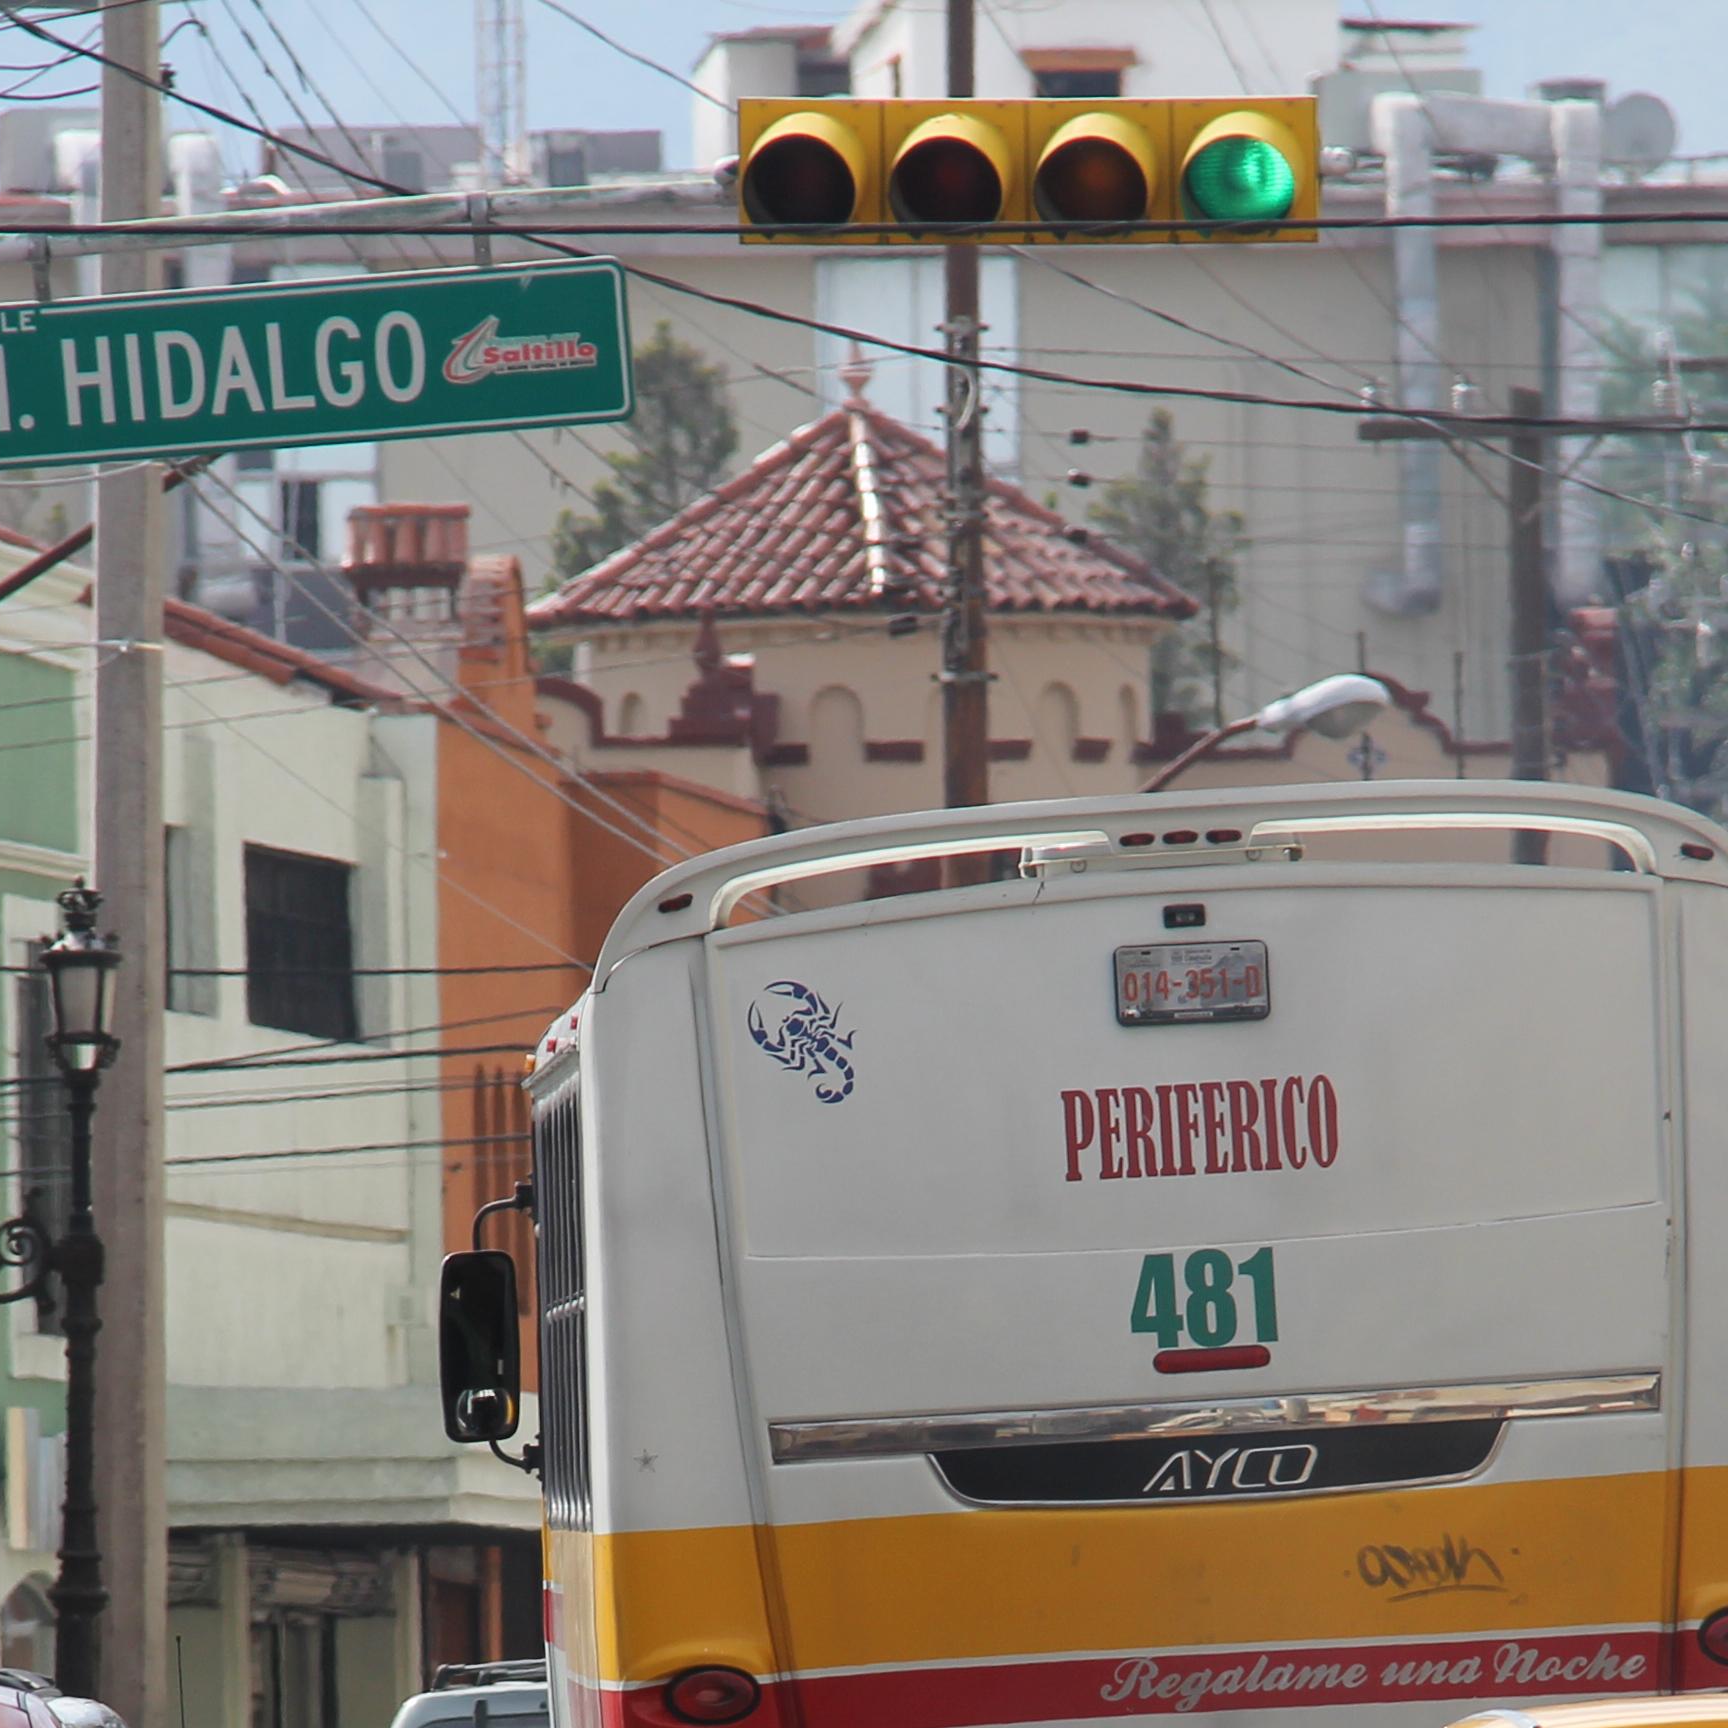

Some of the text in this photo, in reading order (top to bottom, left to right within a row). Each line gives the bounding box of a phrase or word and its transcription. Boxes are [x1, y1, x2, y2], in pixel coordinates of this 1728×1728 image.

[61, 310, 426, 427] HIDALGO
[483, 339, 596, 365] Saltillo
[1123, 964, 1261, 1003] 014-351-D
[1060, 1073, 1340, 1182] PERIFERICO
[1130, 1246, 1279, 1350] 481
[1143, 1443, 1319, 1494] AYCO
[1101, 1642, 1647, 1712] Regalame una Noche
